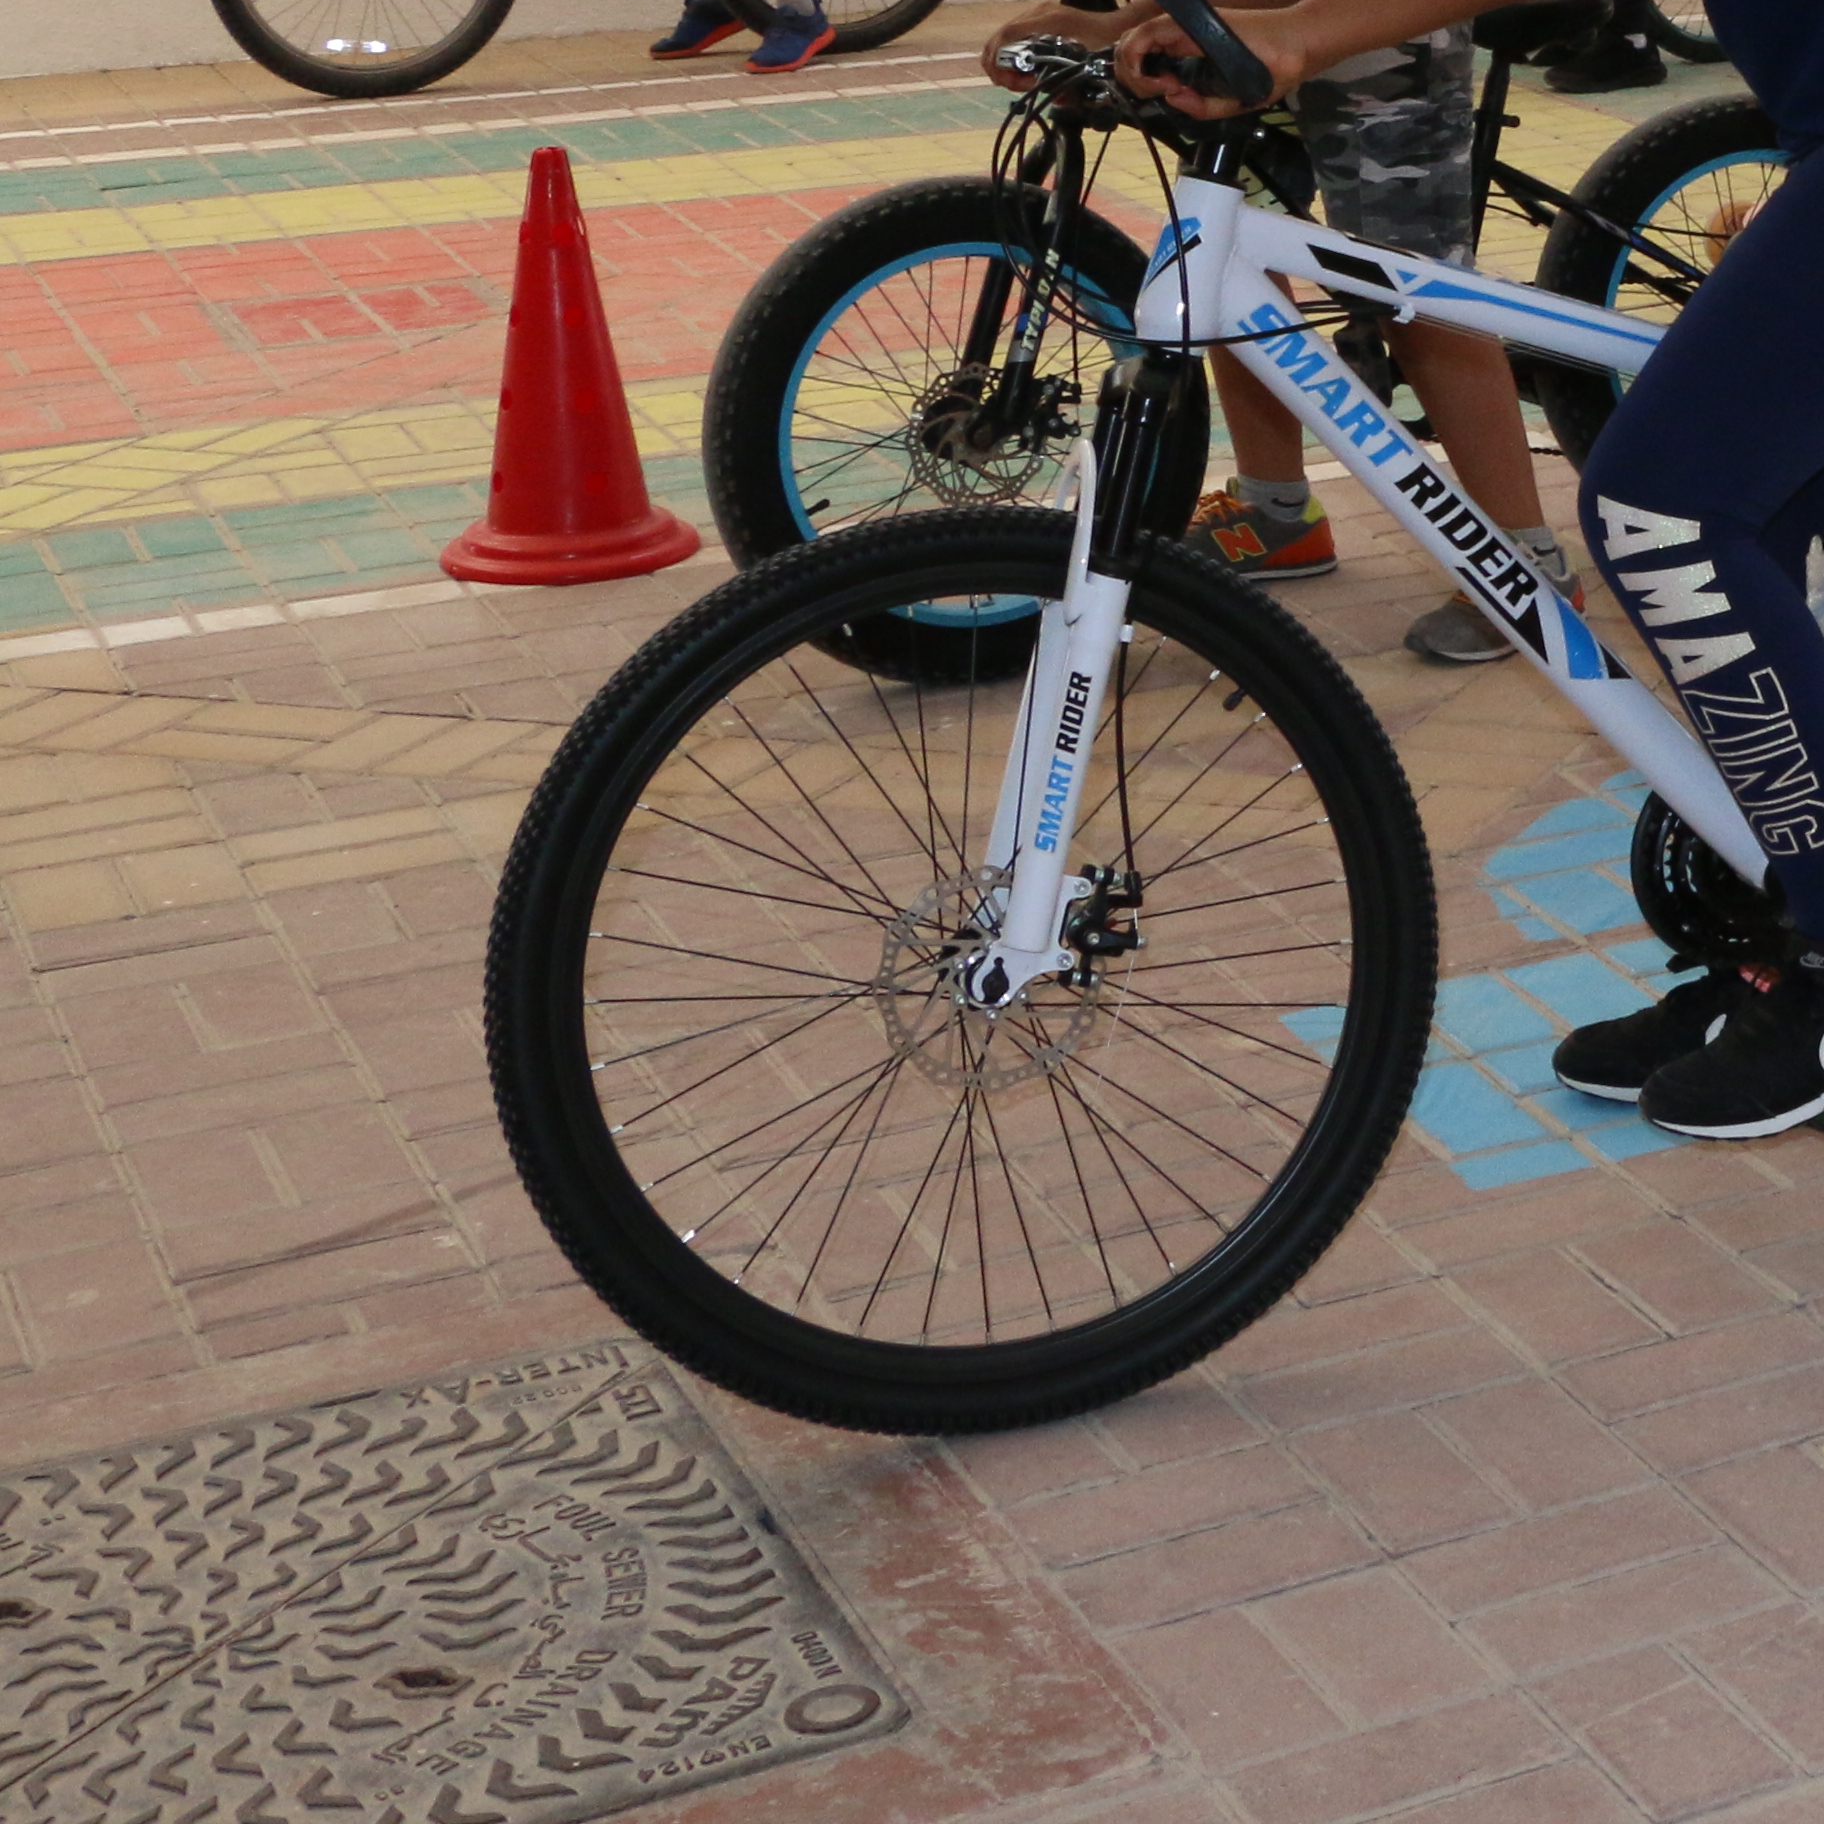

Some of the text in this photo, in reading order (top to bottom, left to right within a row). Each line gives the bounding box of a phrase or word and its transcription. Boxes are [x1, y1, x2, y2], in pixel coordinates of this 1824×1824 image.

[1238, 302, 1540, 608] SMART RIDER
[1035, 671, 1093, 853] SMART RIDER
[399, 1345, 630, 1408] INTER-AX
[532, 1493, 617, 1542] FOUL
[601, 1546, 648, 1621] SEWER
[415, 1648, 617, 1776] DRAINAGE
